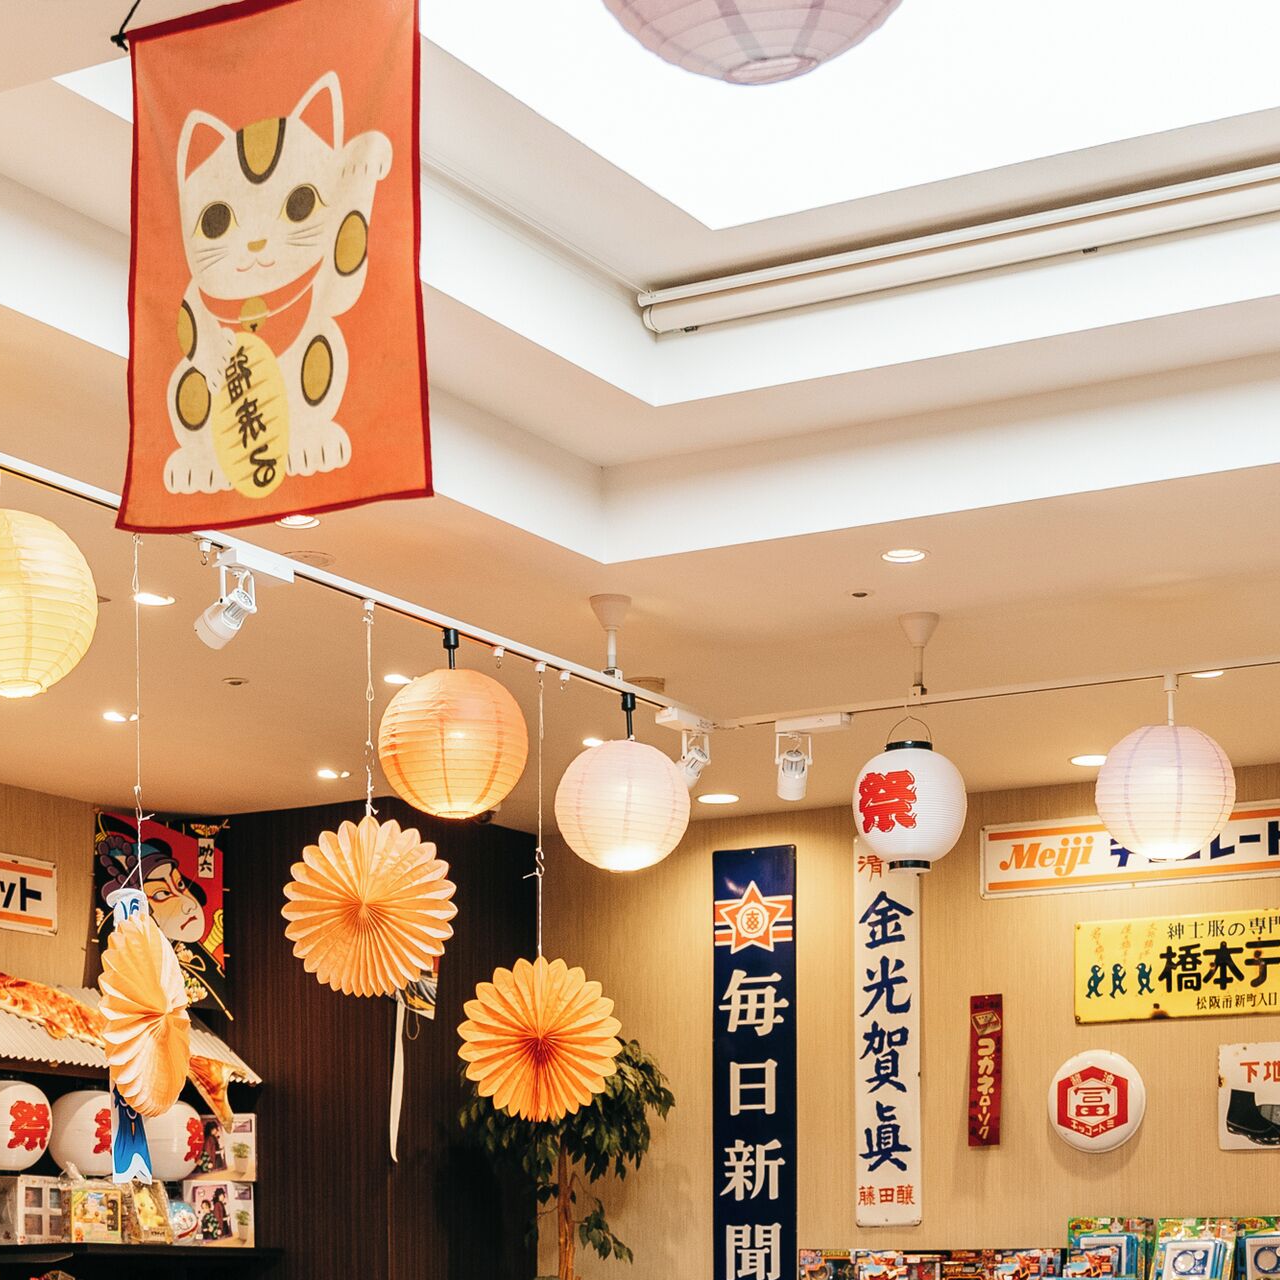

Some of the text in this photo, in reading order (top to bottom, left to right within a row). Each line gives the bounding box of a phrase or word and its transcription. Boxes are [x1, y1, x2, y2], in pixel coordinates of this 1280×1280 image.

[858, 771, 917, 832] 祭
[198, 843, 214, 873] 助六
[998, 835, 1095, 876] Meiji
[1195, 992, 1279, 1010] 松阪市新町入口
[976, 1037, 996, 1140] コガネローソク
[8, 1100, 51, 1152] 祭
